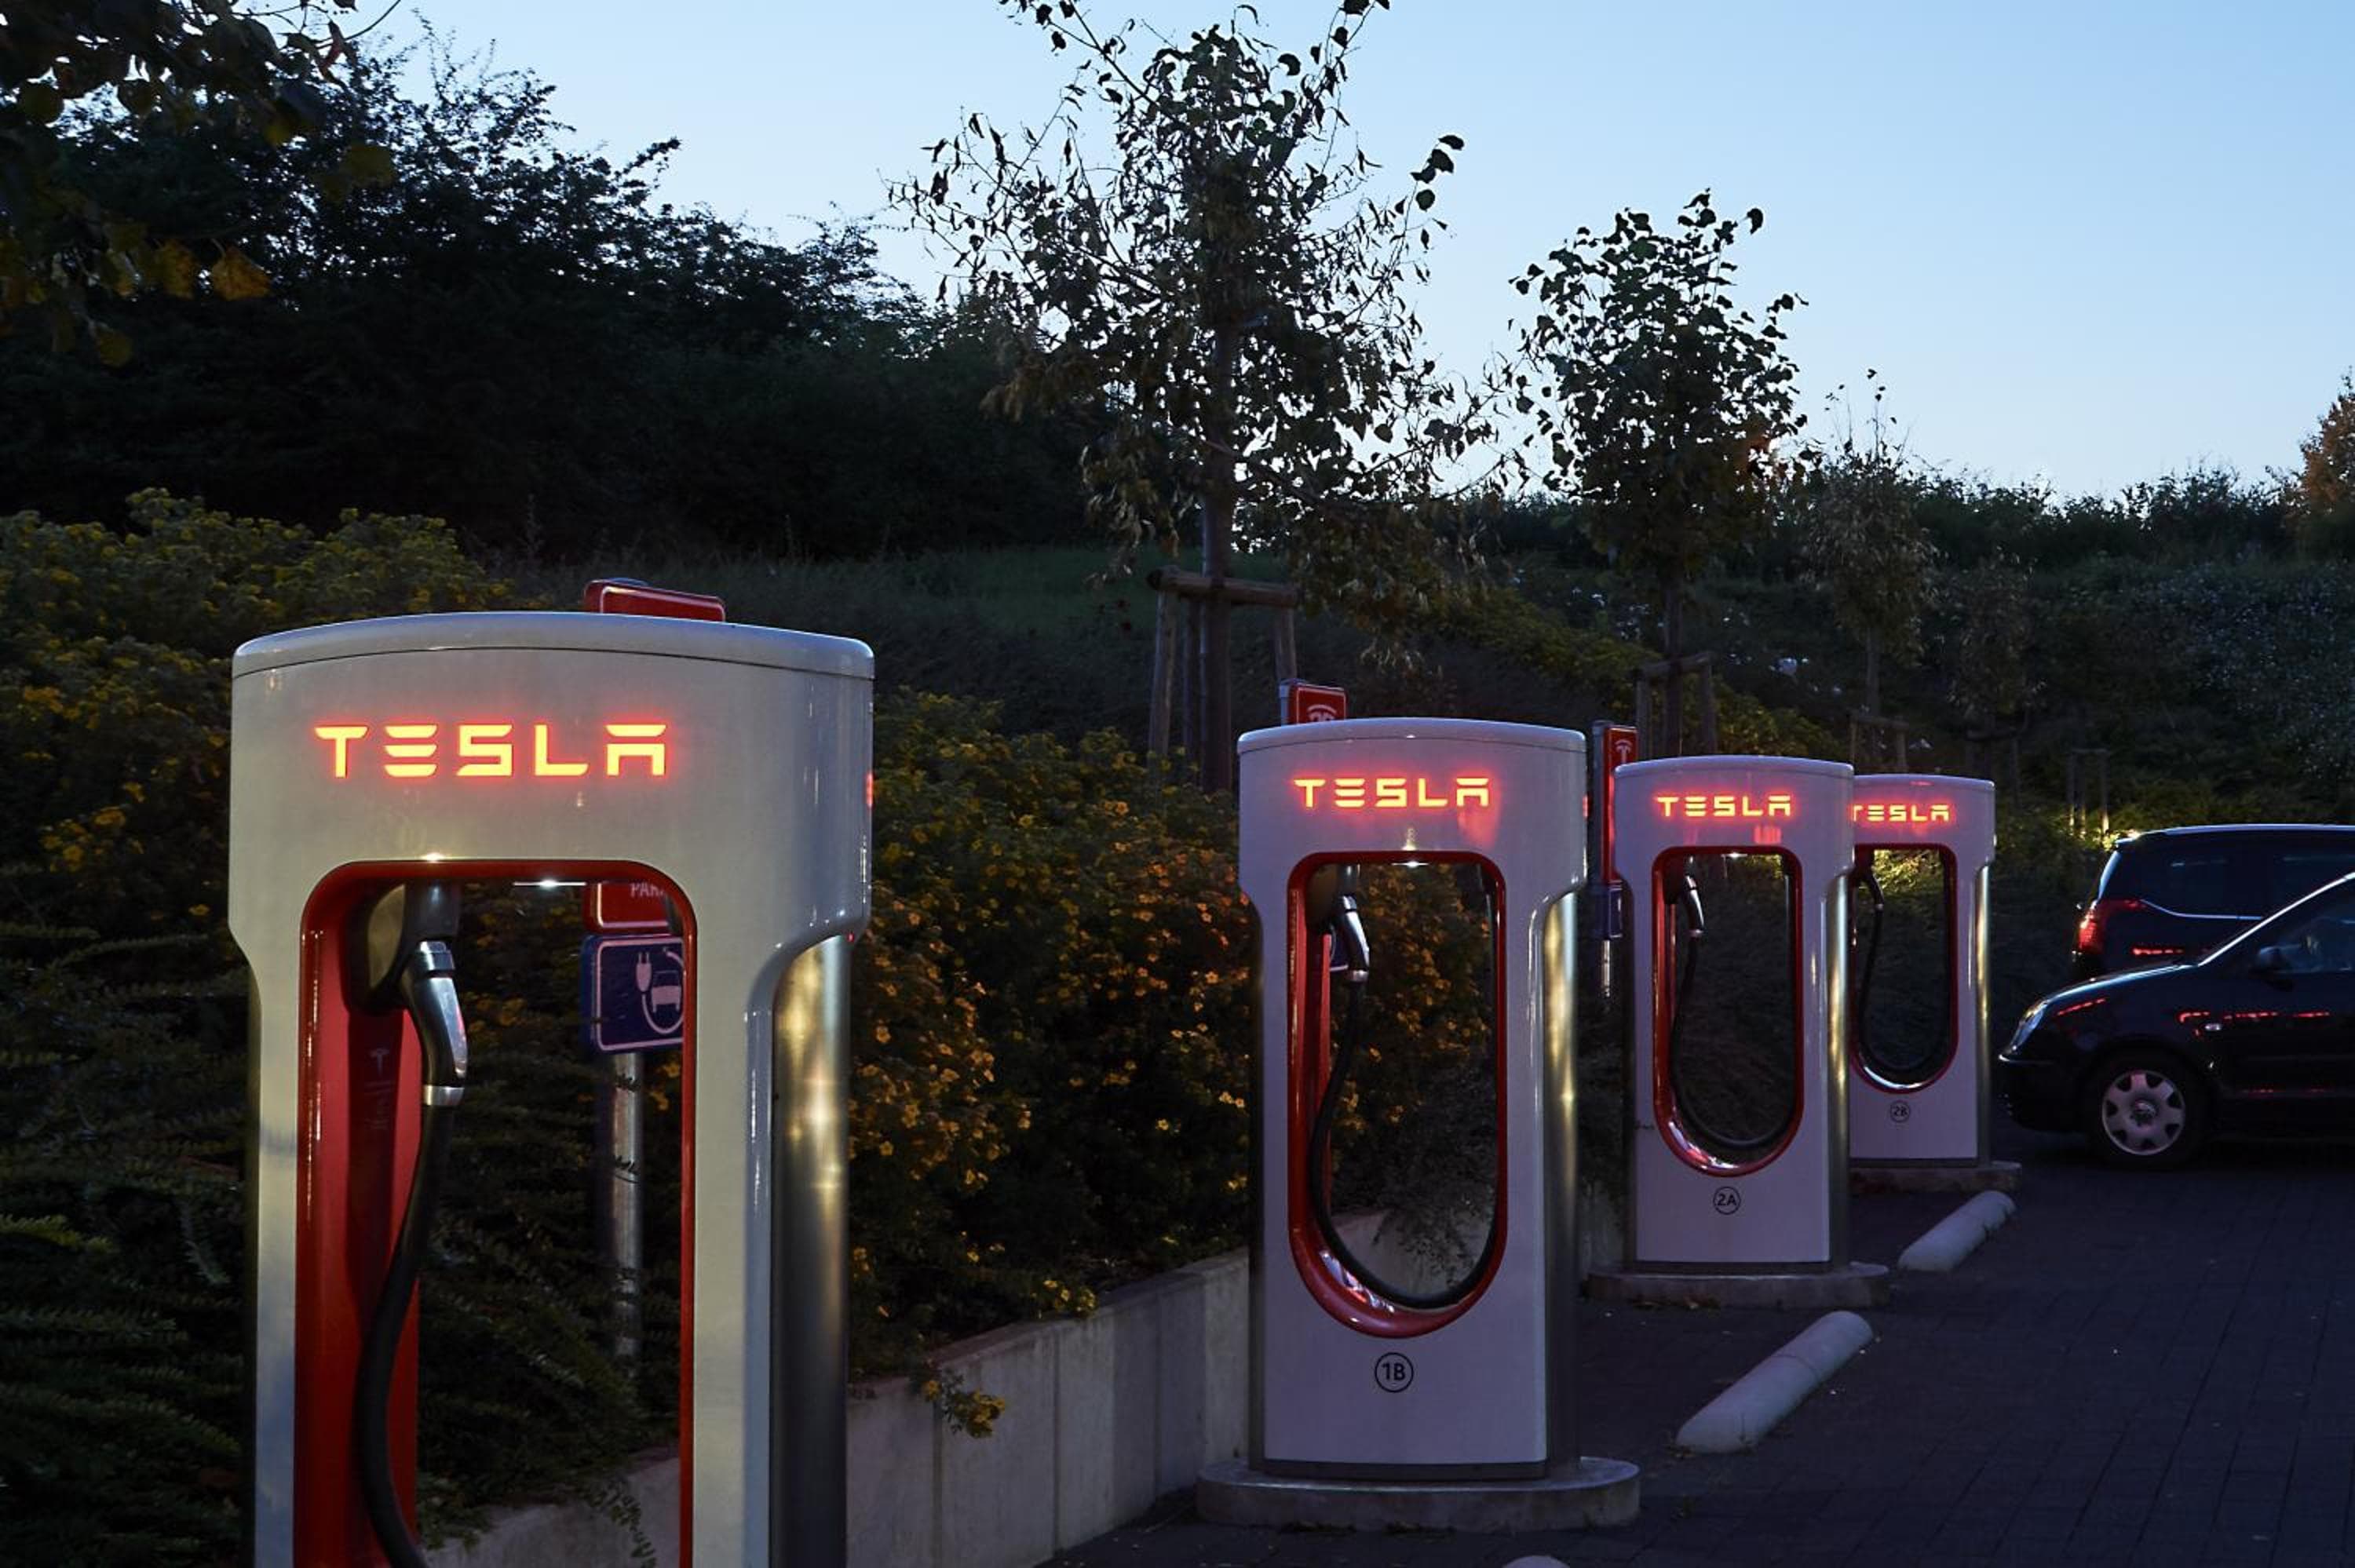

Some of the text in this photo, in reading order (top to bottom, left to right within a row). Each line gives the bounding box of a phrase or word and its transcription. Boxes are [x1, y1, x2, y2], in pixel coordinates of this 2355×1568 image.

[315, 724, 666, 777] TESLA
[1294, 778, 1489, 808] TESLA
[1657, 796, 1791, 817] TESLA
[630, 881, 663, 897] PAR
[1717, 1193, 1736, 1206] 2A
[1382, 1362, 1406, 1381] 1B
